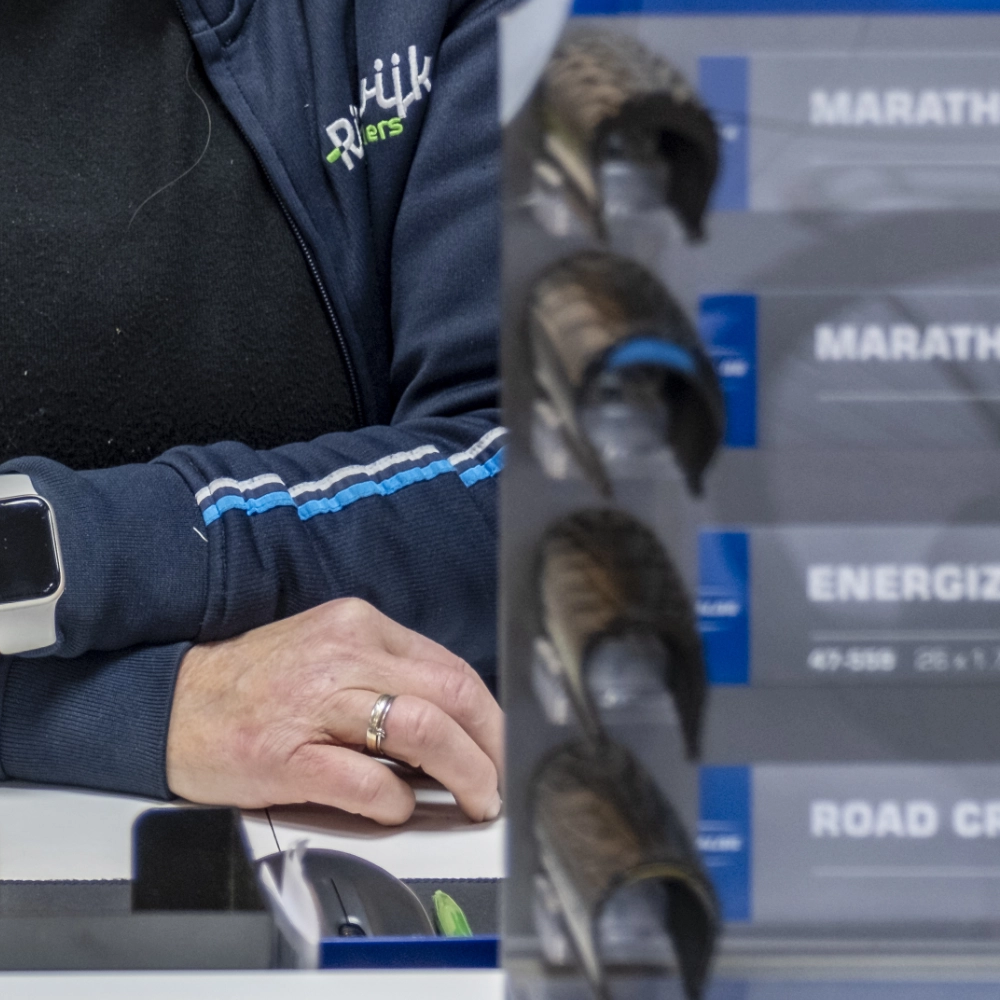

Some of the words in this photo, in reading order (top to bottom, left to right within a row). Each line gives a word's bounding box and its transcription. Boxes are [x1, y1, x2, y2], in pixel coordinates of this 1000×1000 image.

[810, 90, 1000, 126] MARATH
[814, 324, 1000, 362] MARATH
[807, 564, 1000, 602] ENERGIZ
[811, 801, 939, 838] ROAD
